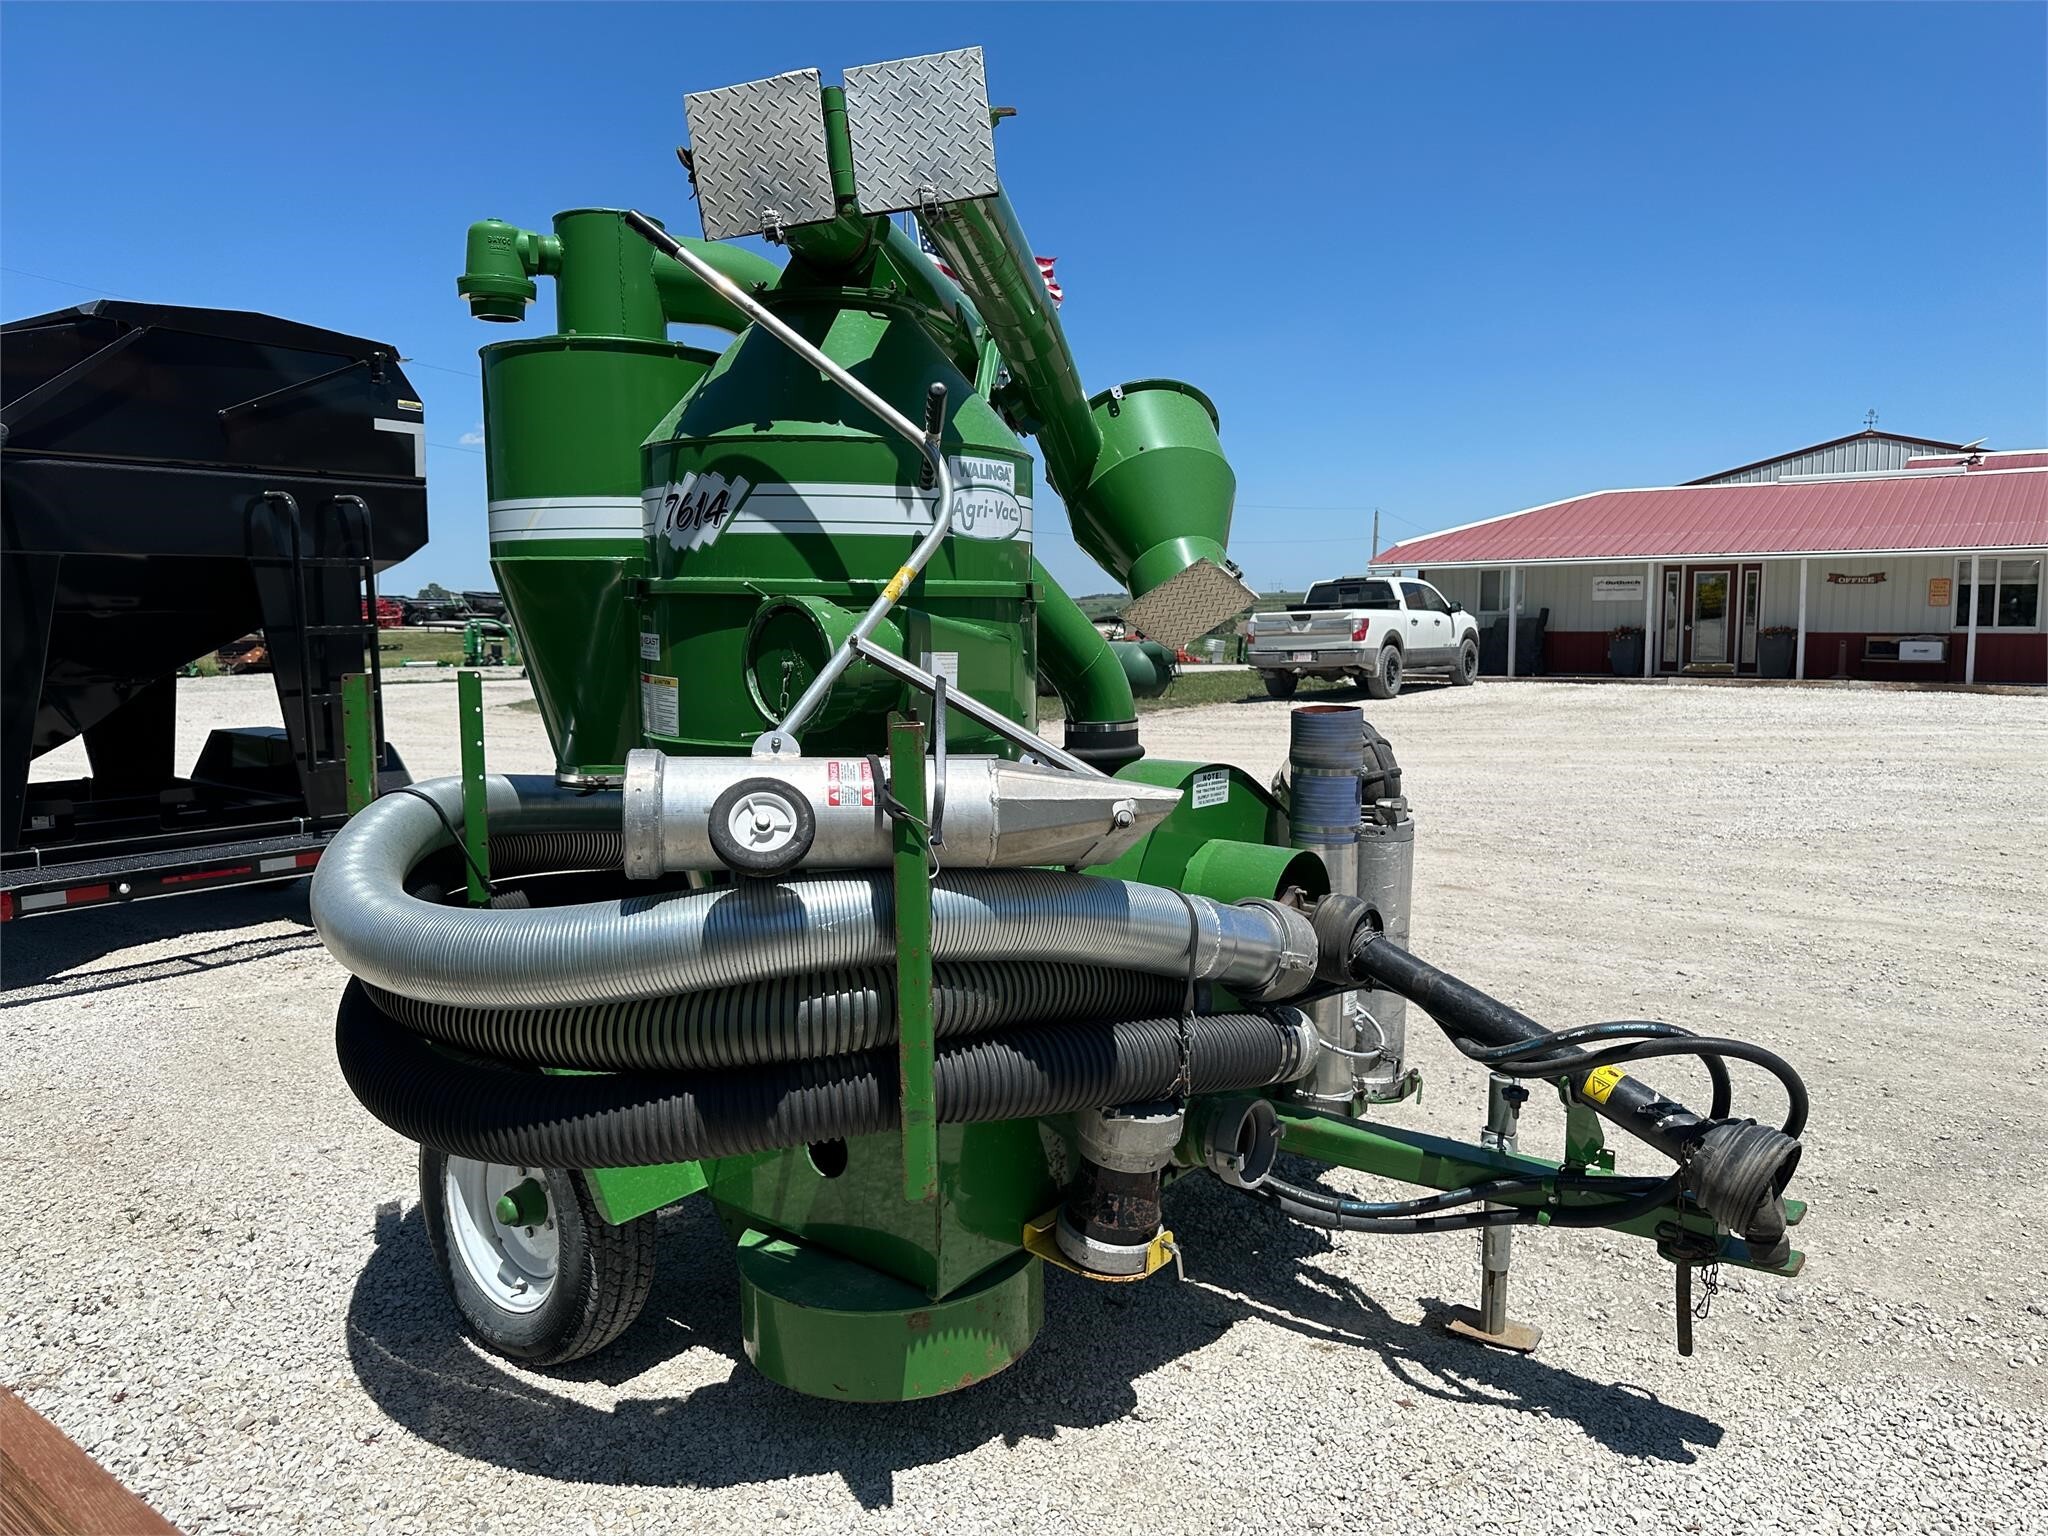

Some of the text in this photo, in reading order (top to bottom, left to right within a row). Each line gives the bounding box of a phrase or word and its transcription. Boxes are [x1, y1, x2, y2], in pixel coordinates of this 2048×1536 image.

[665, 489, 730, 533] 7614
[952, 497, 1019, 530] Agri-Vac
[1838, 576, 1876, 584] OFFICE
[1203, 772, 1222, 781] NOTE!
